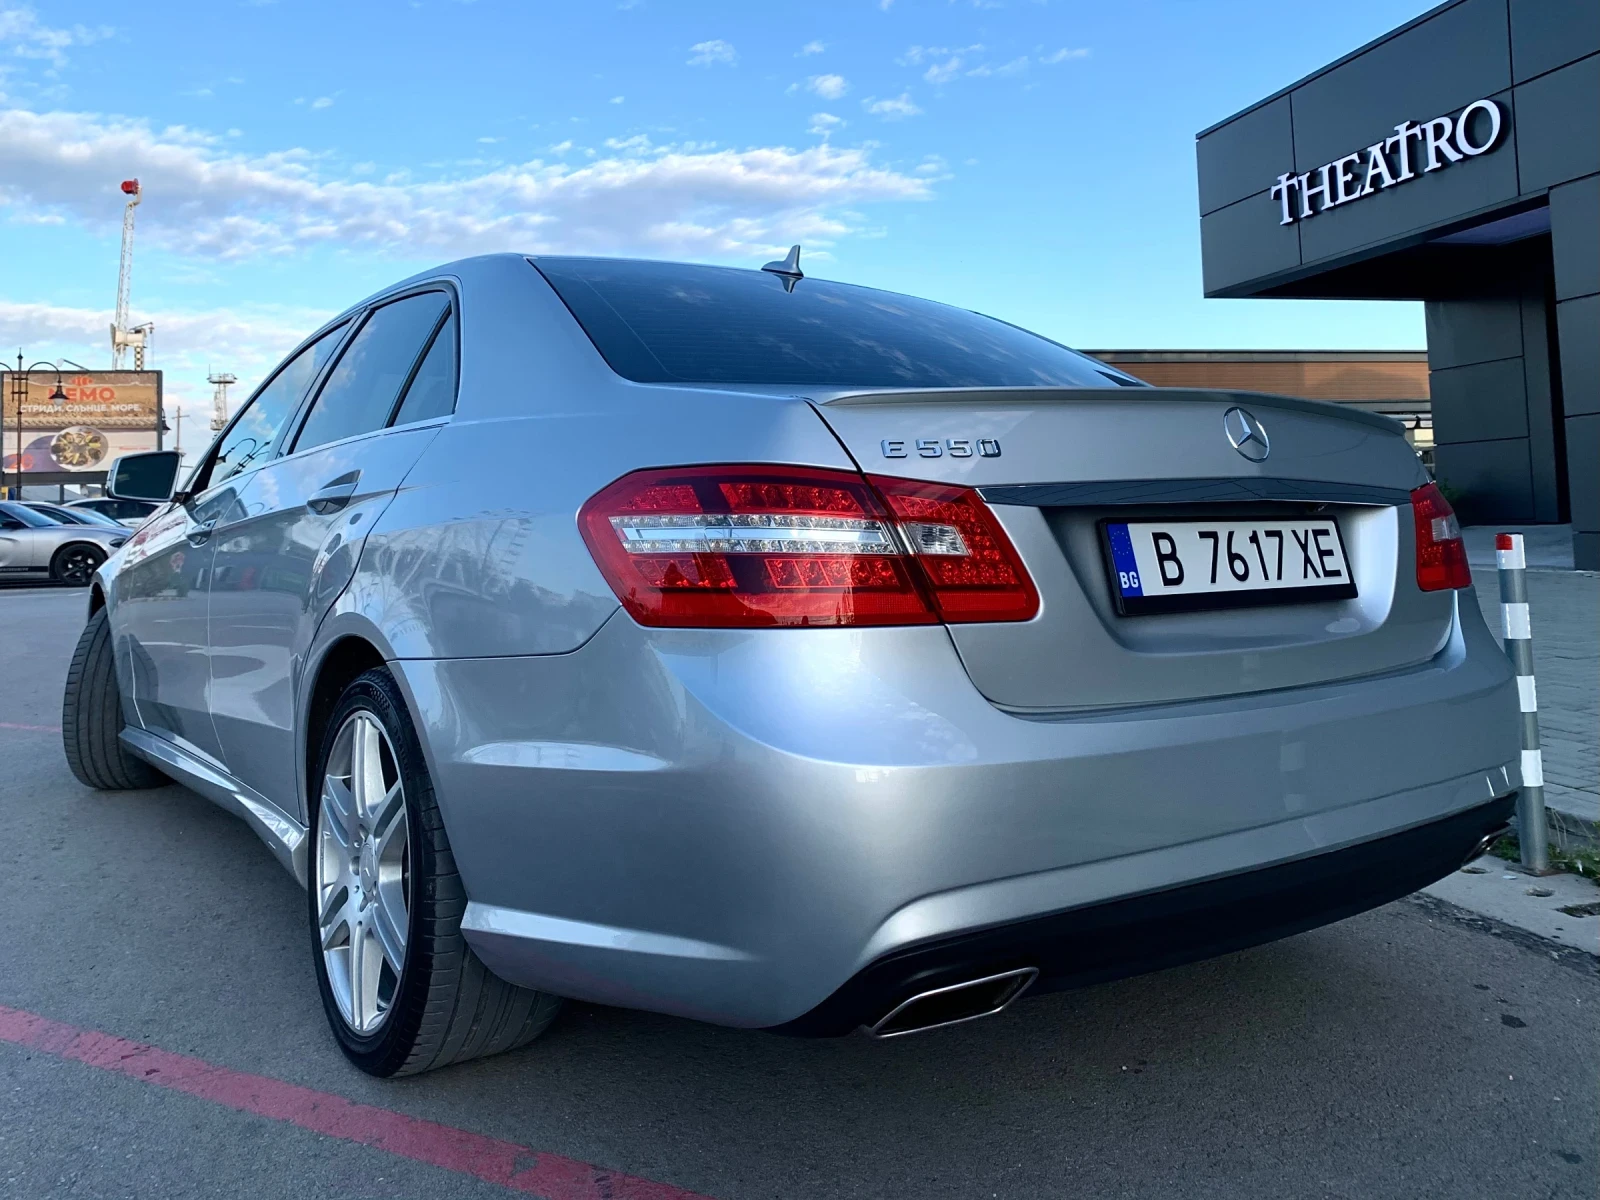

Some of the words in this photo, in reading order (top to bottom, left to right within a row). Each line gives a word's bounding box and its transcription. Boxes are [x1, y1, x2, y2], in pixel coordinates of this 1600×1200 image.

[1271, 99, 1501, 225] THEATRO
[881, 439, 908, 458] E
[915, 439, 1001, 458] 550
[1151, 532, 1185, 586] B
[1197, 530, 1284, 583] 7617
[1291, 529, 1342, 578] XE
[1119, 571, 1139, 589] BG
